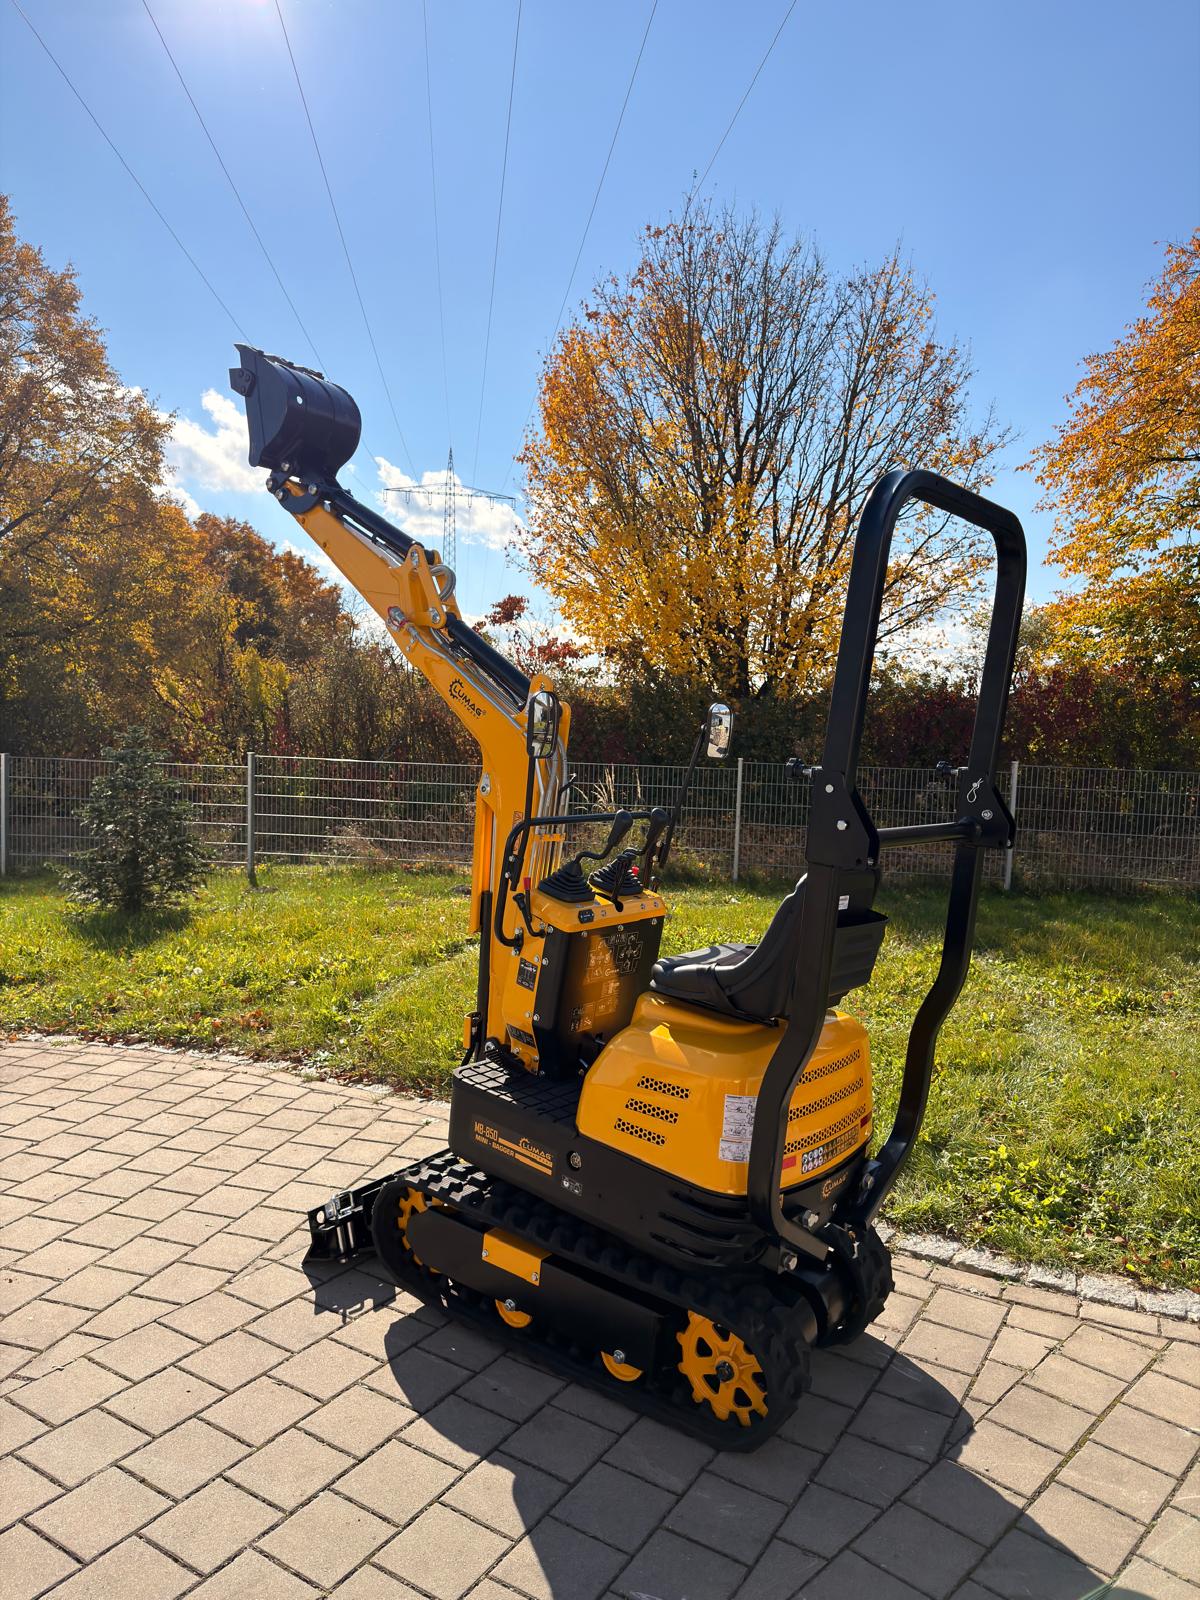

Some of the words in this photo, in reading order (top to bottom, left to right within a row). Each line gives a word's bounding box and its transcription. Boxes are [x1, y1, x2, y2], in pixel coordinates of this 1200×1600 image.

[452, 684, 482, 717] LUMAG
[474, 1121, 498, 1141] MB-850
[522, 1141, 552, 1160] LUMAG
